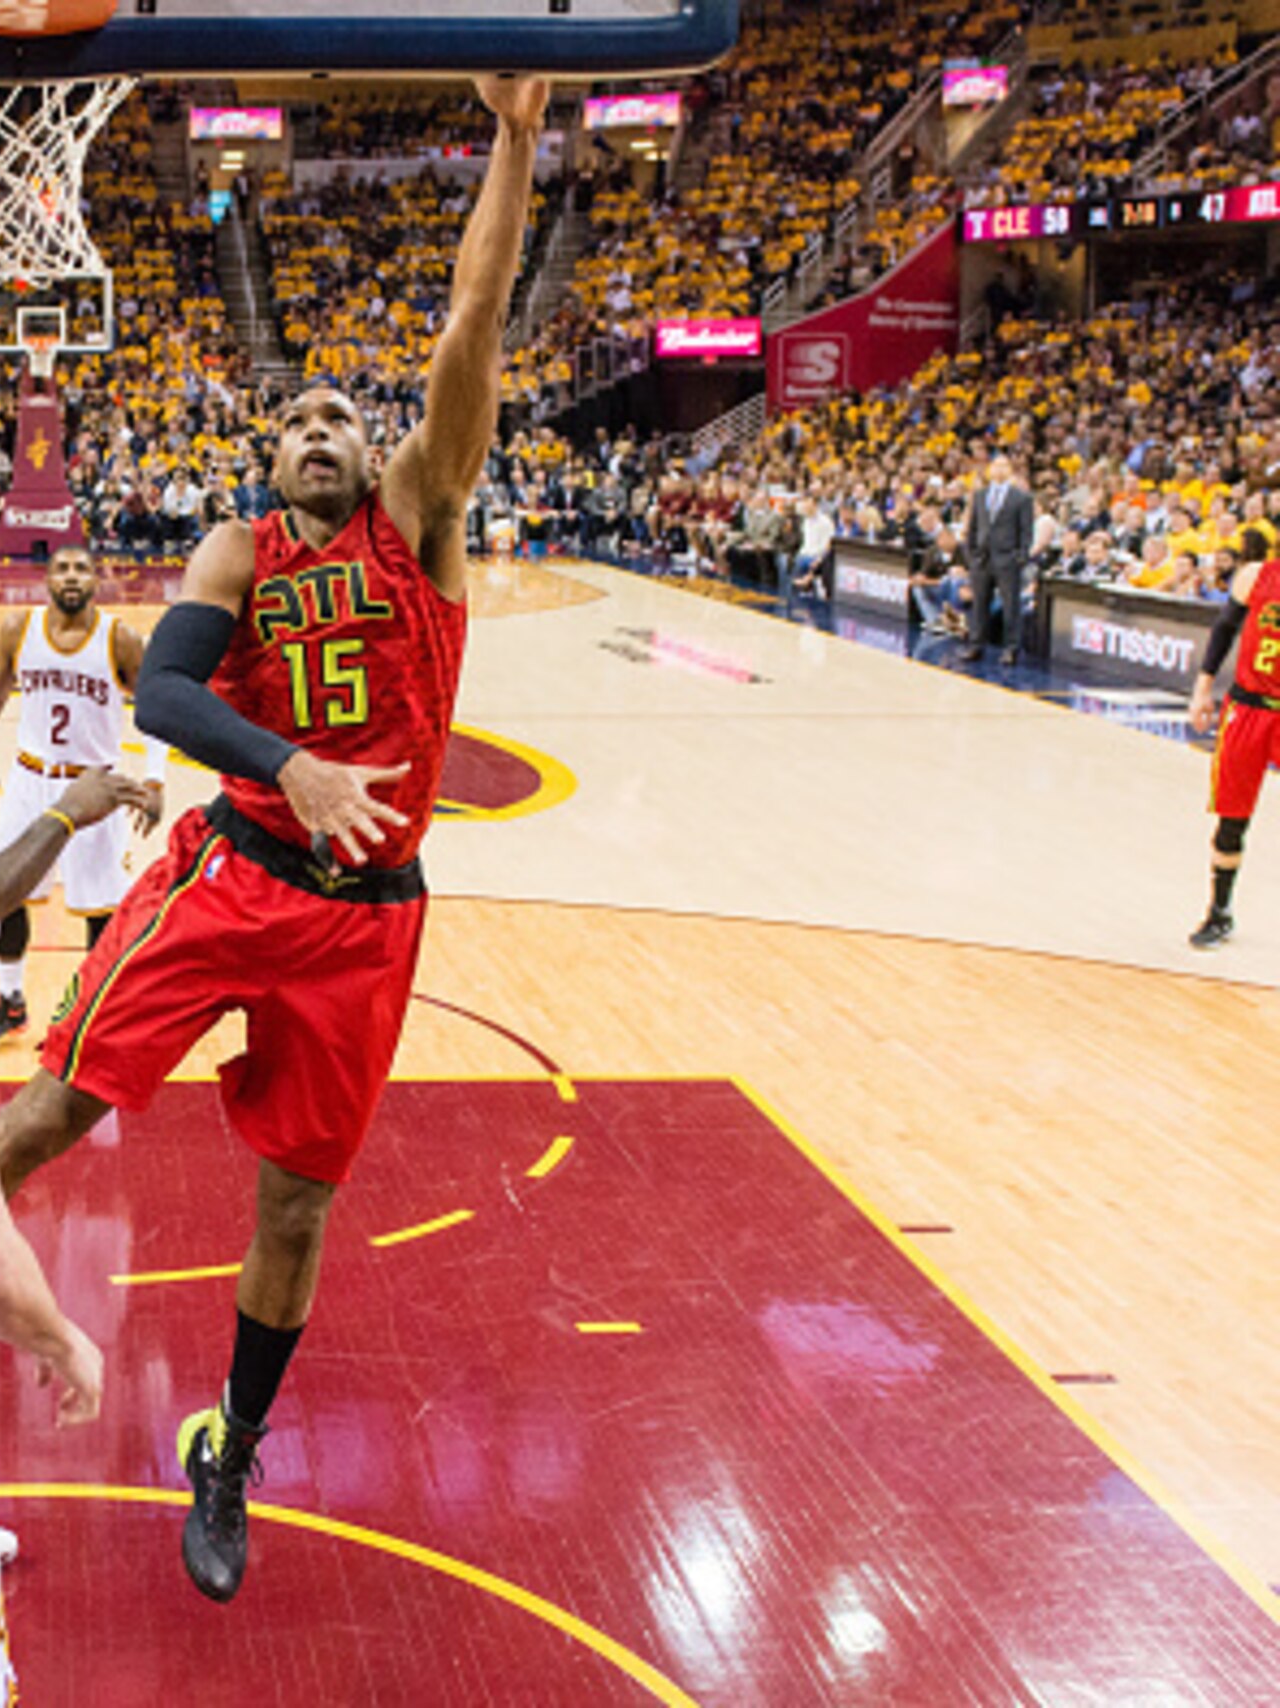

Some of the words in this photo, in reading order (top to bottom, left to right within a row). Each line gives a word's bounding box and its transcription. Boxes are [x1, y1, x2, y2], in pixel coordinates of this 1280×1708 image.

[993, 207, 1031, 239] CLE
[1198, 194, 1225, 222] 47
[254, 561, 395, 649] ATL
[1104, 620, 1195, 674] TISSOT
[21, 667, 109, 706] CAVALIERS
[281, 638, 370, 729] 15
[50, 704, 71, 746] 2
